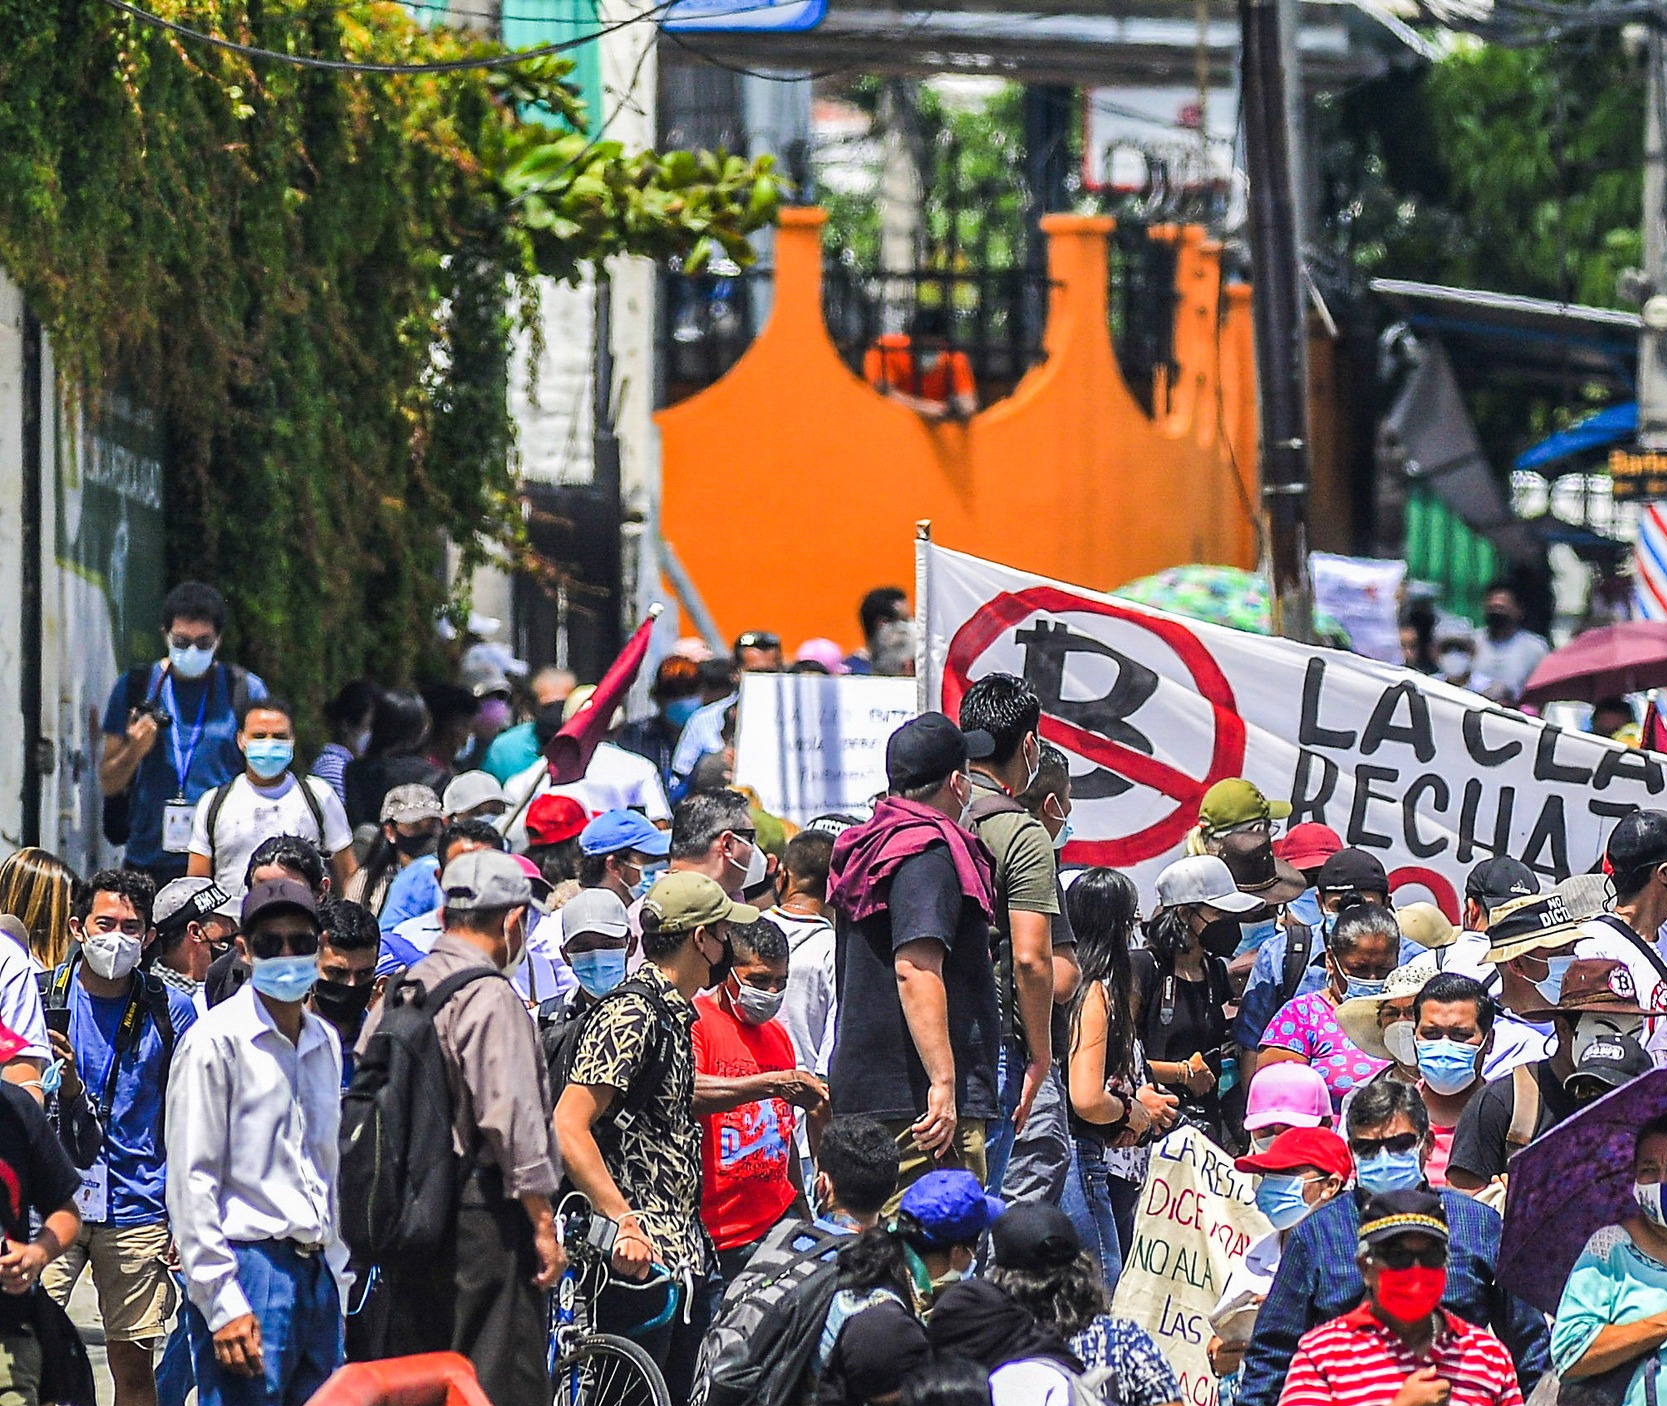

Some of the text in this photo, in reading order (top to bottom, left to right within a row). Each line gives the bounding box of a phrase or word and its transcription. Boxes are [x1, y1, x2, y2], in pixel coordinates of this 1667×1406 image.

[1299, 656, 1437, 763] LA
[1546, 897, 1566, 913] NO
[123, 1001, 137, 1028] Nikon
[1159, 1136, 1197, 1168] LA
[1146, 1178, 1206, 1231] DICE
[1132, 1234, 1168, 1275] NO
[1159, 1294, 1203, 1345] LAS
